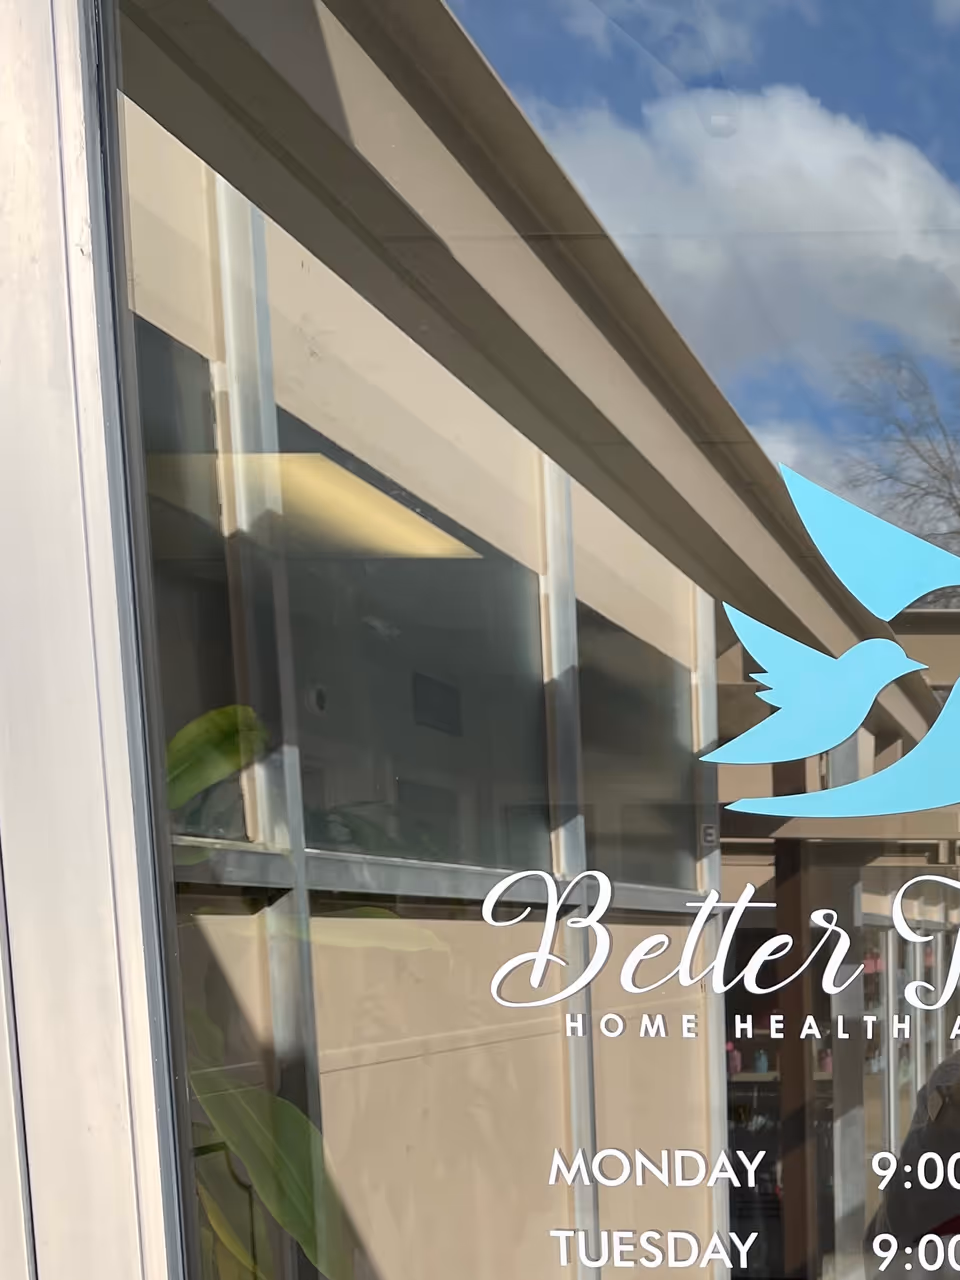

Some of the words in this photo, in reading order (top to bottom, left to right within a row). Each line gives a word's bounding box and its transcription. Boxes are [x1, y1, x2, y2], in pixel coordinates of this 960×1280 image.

[482, 870, 865, 1008] Better
[565, 1013, 696, 1038] HOME
[735, 1014, 910, 1039] HEALTH
[548, 1148, 766, 1188] MONDAY
[549, 1230, 758, 1269] TUESDAY
